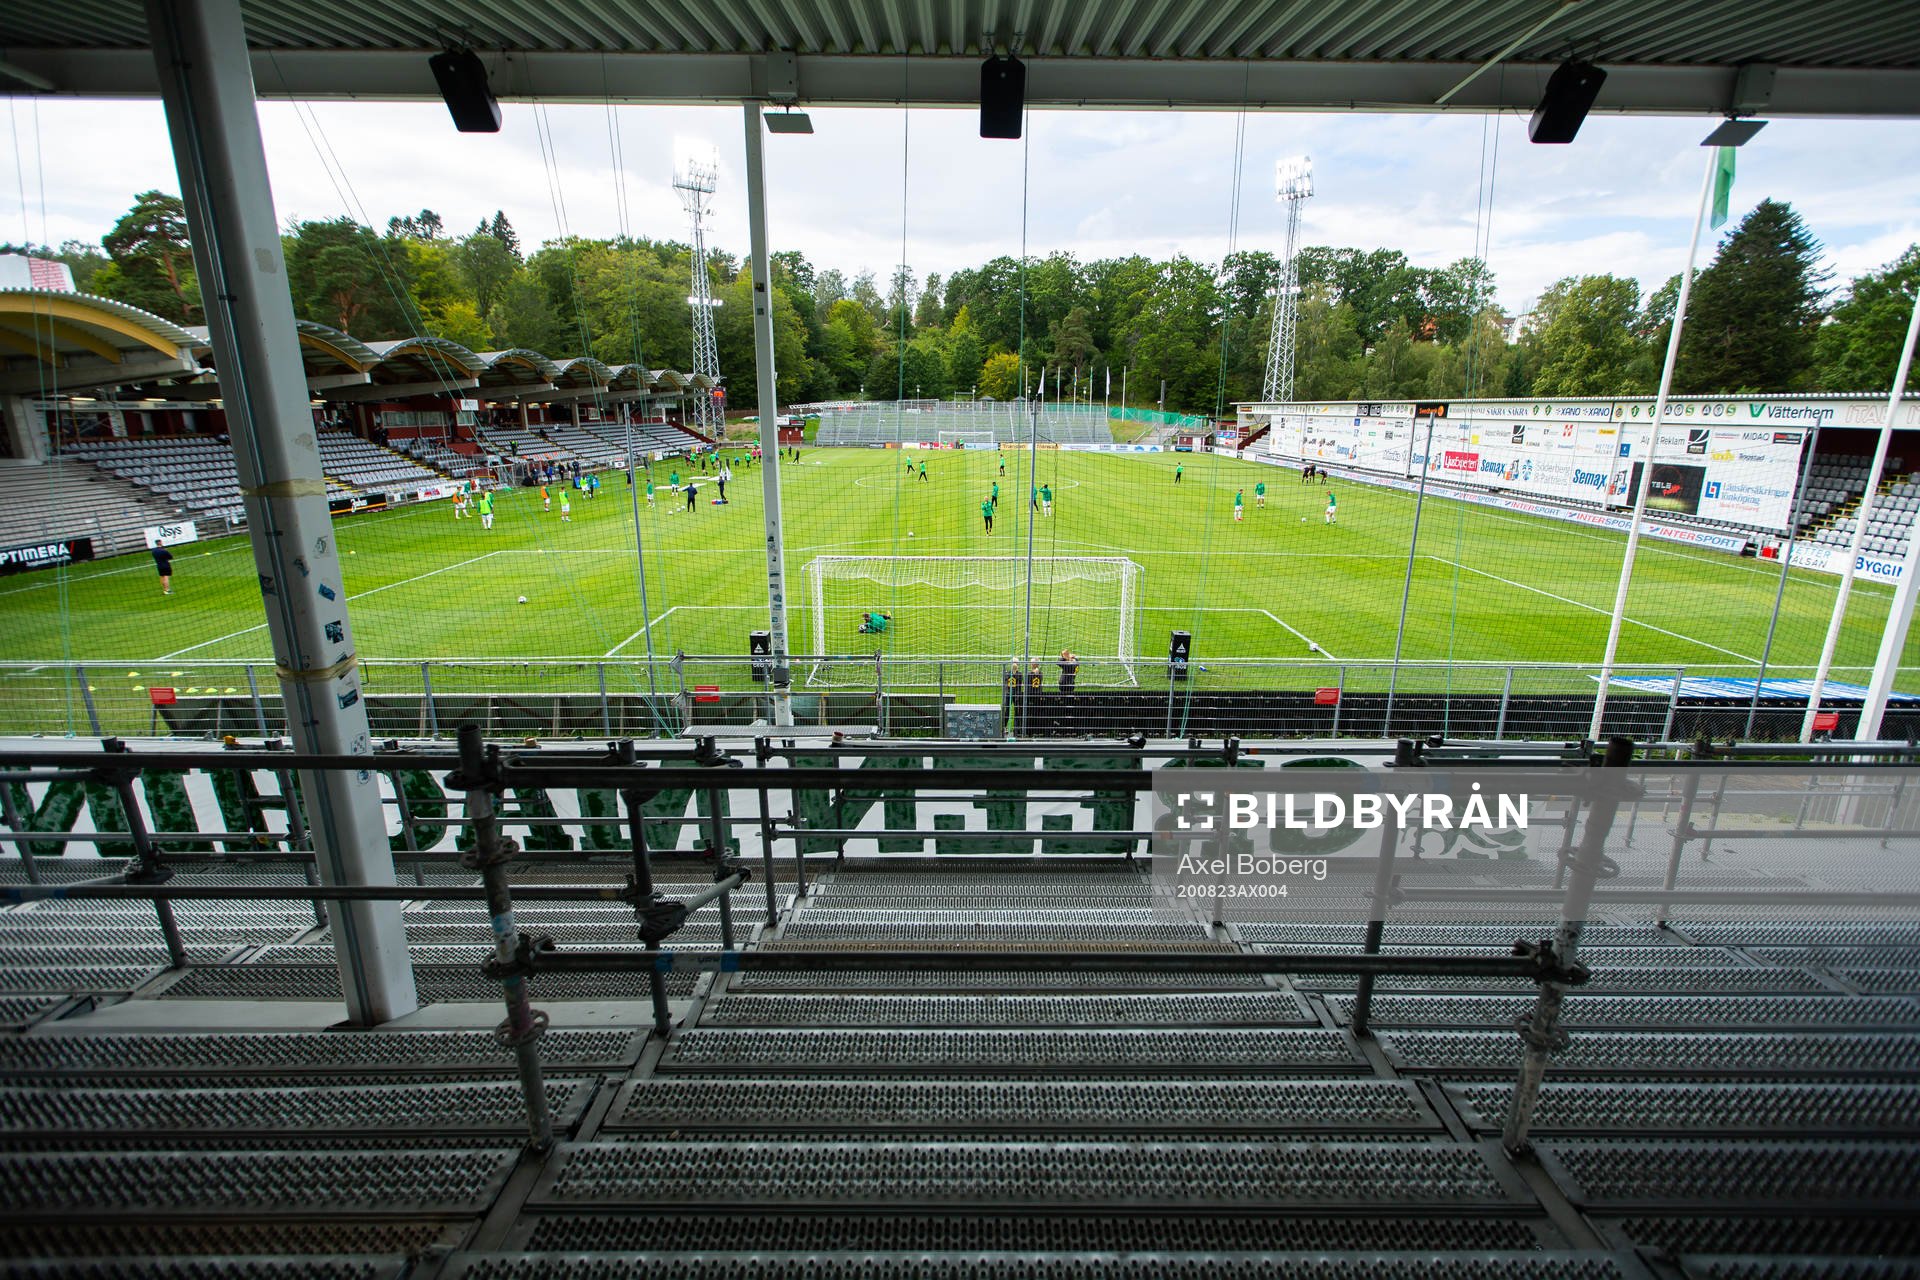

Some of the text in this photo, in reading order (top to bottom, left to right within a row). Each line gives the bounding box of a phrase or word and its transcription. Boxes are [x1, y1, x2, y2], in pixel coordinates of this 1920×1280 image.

[1561, 407, 1580, 416] XANO
[1588, 407, 1610, 416] XANO
[1767, 405, 1834, 419] Vätterhem
[1660, 436, 1686, 445] Reklam
[1481, 459, 1505, 476] Semax
[1572, 468, 1608, 490] Semax
[1460, 491, 1498, 505] INTERSPORT
[1510, 501, 1560, 516] INTERSPORT
[1576, 512, 1633, 529] INTERSPOR
[158, 525, 182, 539] Qsys
[1659, 526, 1740, 549] INTERSPORT
[1793, 546, 1832, 559] ETTER
